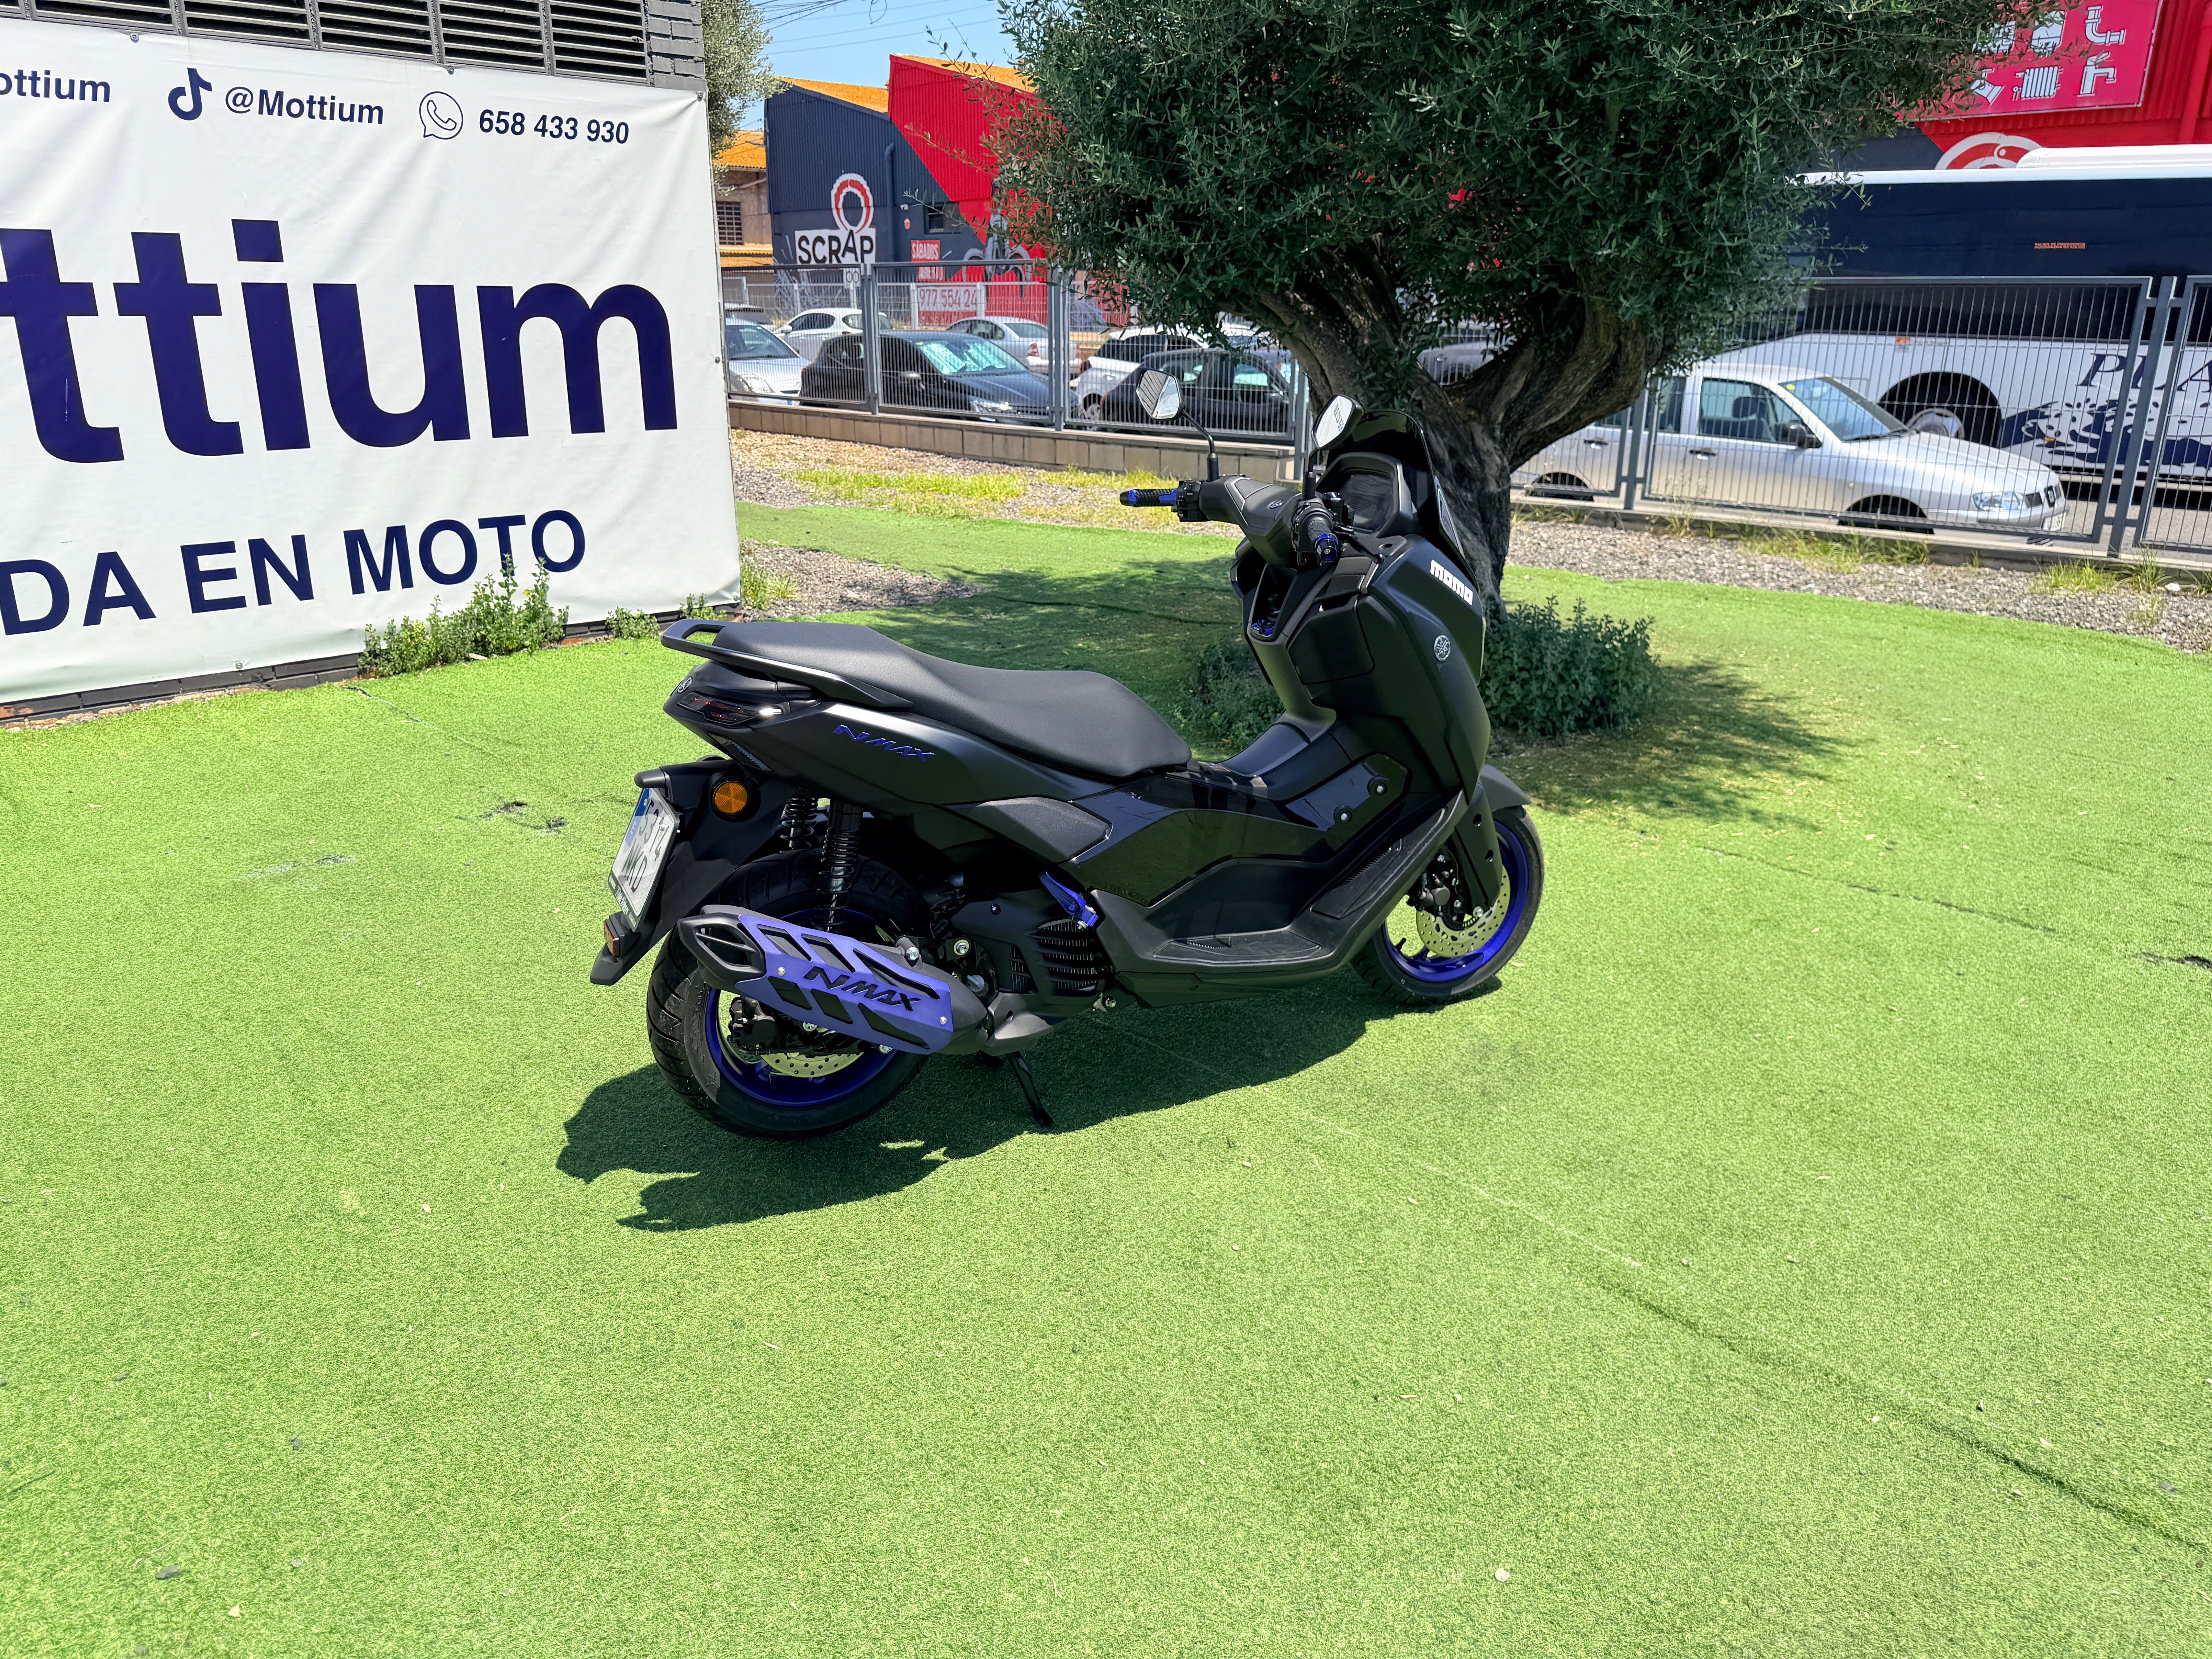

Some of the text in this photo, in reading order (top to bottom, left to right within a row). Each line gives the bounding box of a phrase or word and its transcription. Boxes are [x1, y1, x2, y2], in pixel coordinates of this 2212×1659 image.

[225, 86, 383, 124] @Mottium
[479, 109, 525, 136] 658
[534, 115, 578, 140] 433
[587, 119, 629, 144] 930
[798, 229, 874, 264] SCRAP
[919, 289, 938, 306] 977
[941, 289, 961, 307] 554
[0, 218, 678, 463] ttium
[0, 510, 586, 635] DA EN MOTO
[833, 724, 936, 762] NMAX
[622, 838, 647, 893] NKD
[804, 966, 921, 1012] NMAX
